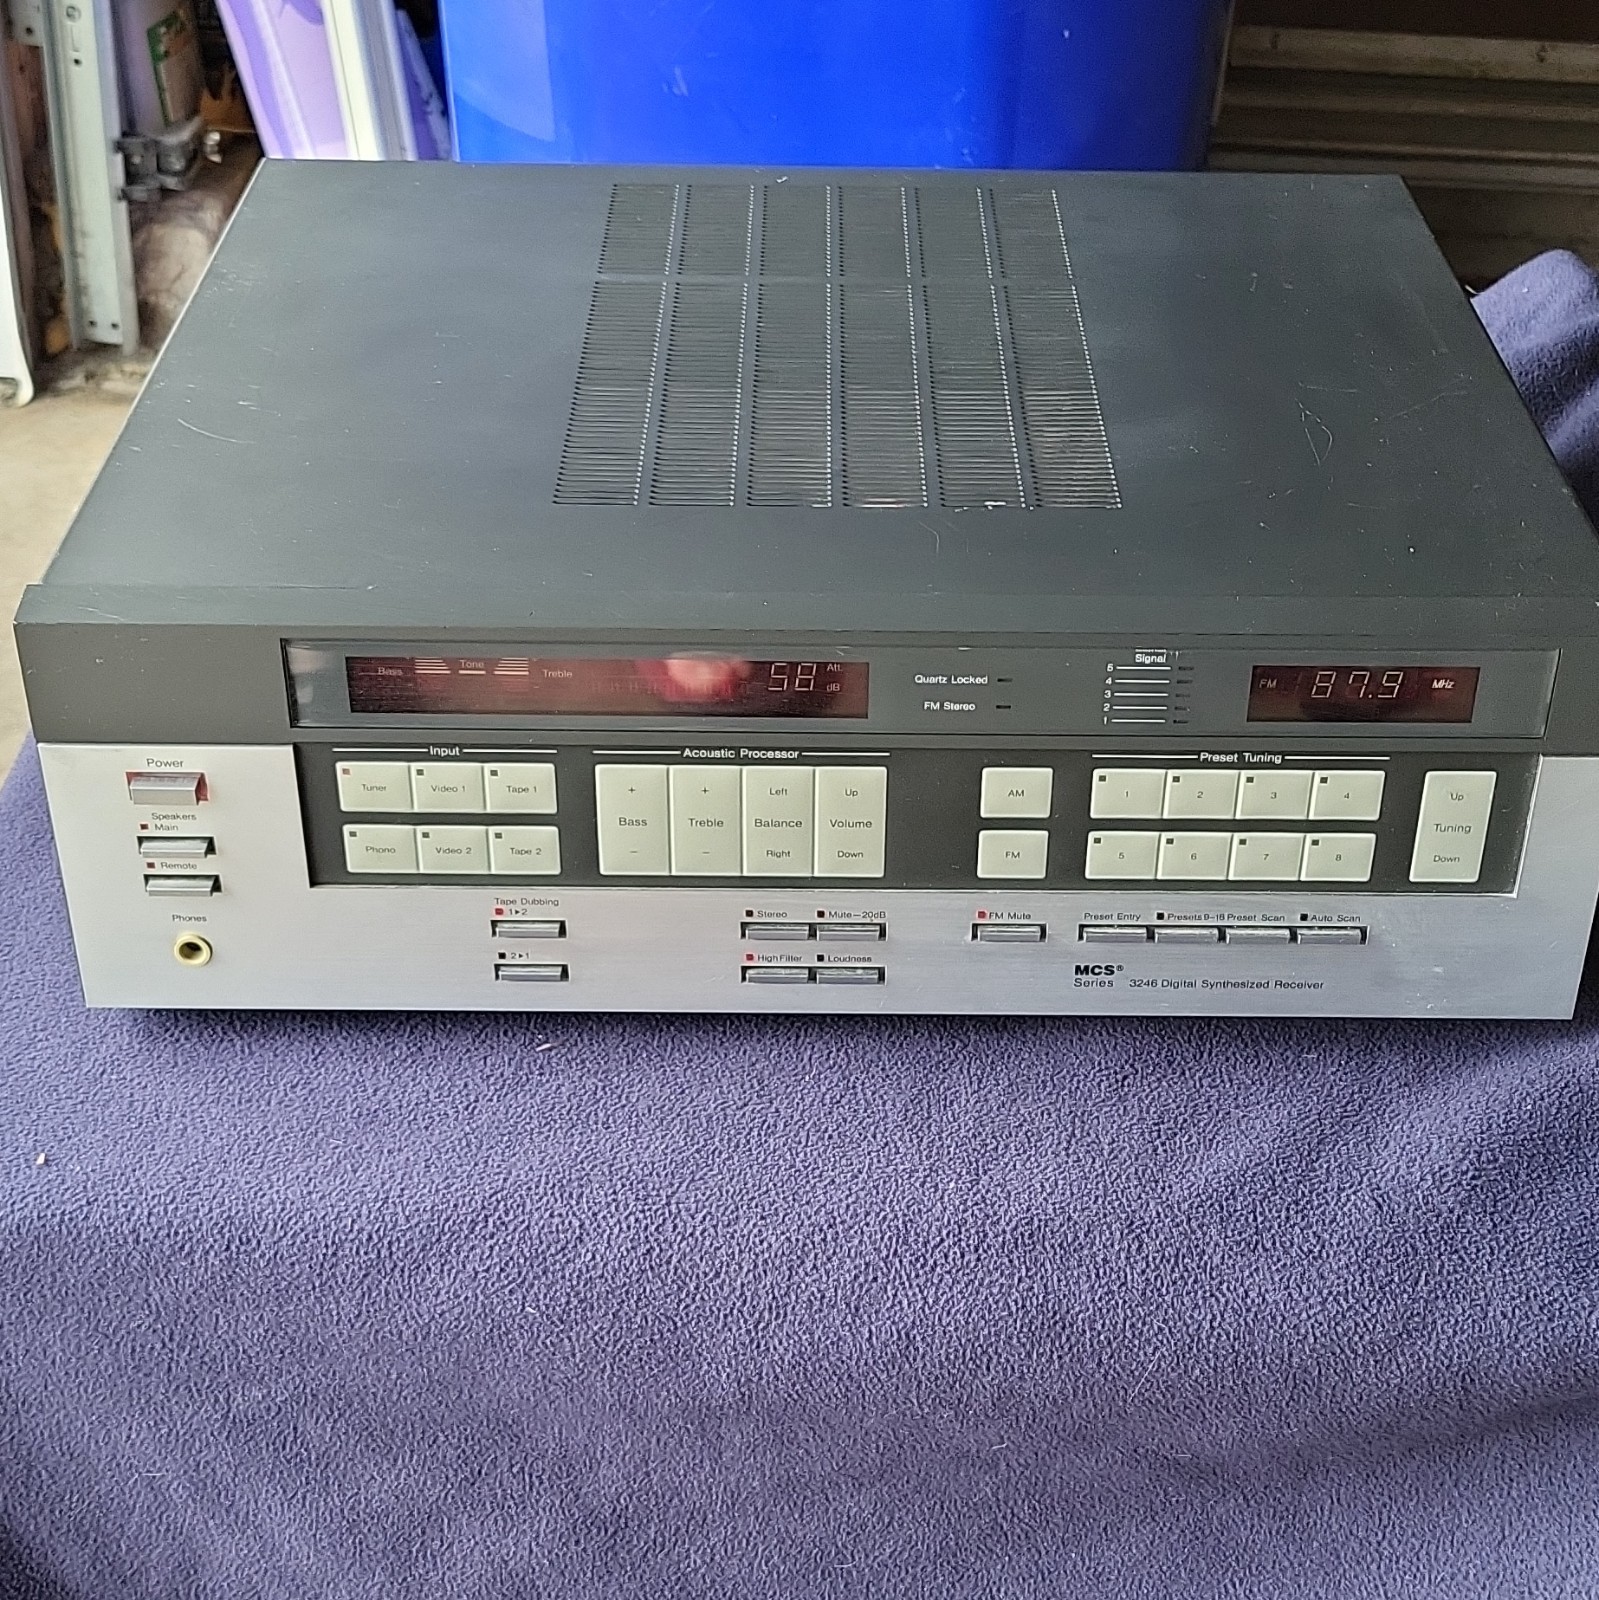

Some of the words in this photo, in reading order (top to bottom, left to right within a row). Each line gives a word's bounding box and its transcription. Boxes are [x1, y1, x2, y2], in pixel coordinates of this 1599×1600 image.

[1135, 653, 1167, 664] Signal
[460, 660, 485, 668] Tone
[378, 667, 403, 676] Bass
[543, 669, 573, 678] Treble
[768, 663, 817, 691] 58
[914, 674, 948, 685] Quartz
[951, 674, 988, 685] Locked
[1105, 677, 1112, 685] 4
[827, 683, 840, 692] dB
[1259, 679, 1277, 689] FM
[1311, 671, 1403, 698] 87.9
[1432, 679, 1454, 689] MHz
[1104, 690, 1111, 699] 3
[924, 702, 940, 711] FM
[943, 702, 976, 712] Stereo
[1103, 703, 1110, 712] 2
[1103, 717, 1108, 725] 1
[429, 746, 461, 757] Input
[683, 748, 735, 760] Acoustic
[739, 749, 799, 760] Processor
[1200, 752, 1238, 763] Preset
[1243, 752, 1282, 764] Tuning
[146, 758, 184, 768] Power
[361, 783, 387, 792] Tuner
[430, 784, 458, 793] Video
[506, 785, 529, 795] Tape
[769, 787, 788, 796] Left
[845, 788, 858, 798] Up
[1007, 789, 1025, 798] AM
[1197, 791, 1203, 799] 2
[1270, 791, 1277, 800] 3
[1343, 791, 1350, 800] 4
[1450, 792, 1464, 801] Up
[151, 812, 197, 822] Speakers
[618, 817, 648, 828] Bass
[688, 818, 724, 829] Treble
[754, 819, 803, 829] Balance
[829, 819, 873, 830] Volume
[154, 823, 179, 832] Main
[1433, 823, 1472, 834] Tuning
[365, 845, 396, 854] Phono
[435, 846, 462, 855] Video
[466, 847, 472, 855] 2
[509, 847, 532, 856] Tape
[535, 847, 542, 856] 2
[766, 850, 791, 859] Right
[837, 850, 864, 859] Down
[1005, 851, 1020, 859] FM
[1118, 852, 1125, 860] 5
[1191, 852, 1197, 861] 6
[1262, 853, 1269, 862] 7
[1335, 853, 1342, 862] 8
[1433, 854, 1460, 863] Down
[160, 861, 197, 870] Remote
[494, 897, 517, 905] Tape
[520, 897, 559, 906] Dubbing
[172, 913, 207, 922] Phones
[757, 910, 788, 918] Stereo
[1007, 912, 1031, 920] Mute
[1084, 912, 1114, 921] Preset
[1117, 913, 1141, 922] Entry
[1167, 913, 1202, 922] Presets
[1227, 914, 1257, 922] Preset
[1261, 914, 1285, 922] Scan
[1311, 914, 1333, 922] Auto
[1337, 914, 1361, 922] Scan
[757, 955, 778, 963] High
[780, 955, 802, 963] Filter
[828, 955, 872, 963] Loudness
[1074, 979, 1114, 988] Series
[1129, 979, 1157, 988] 3246
[1161, 979, 1197, 989] Digital
[1201, 980, 1269, 990] Synthesized
[1274, 980, 1324, 989] Receiver
